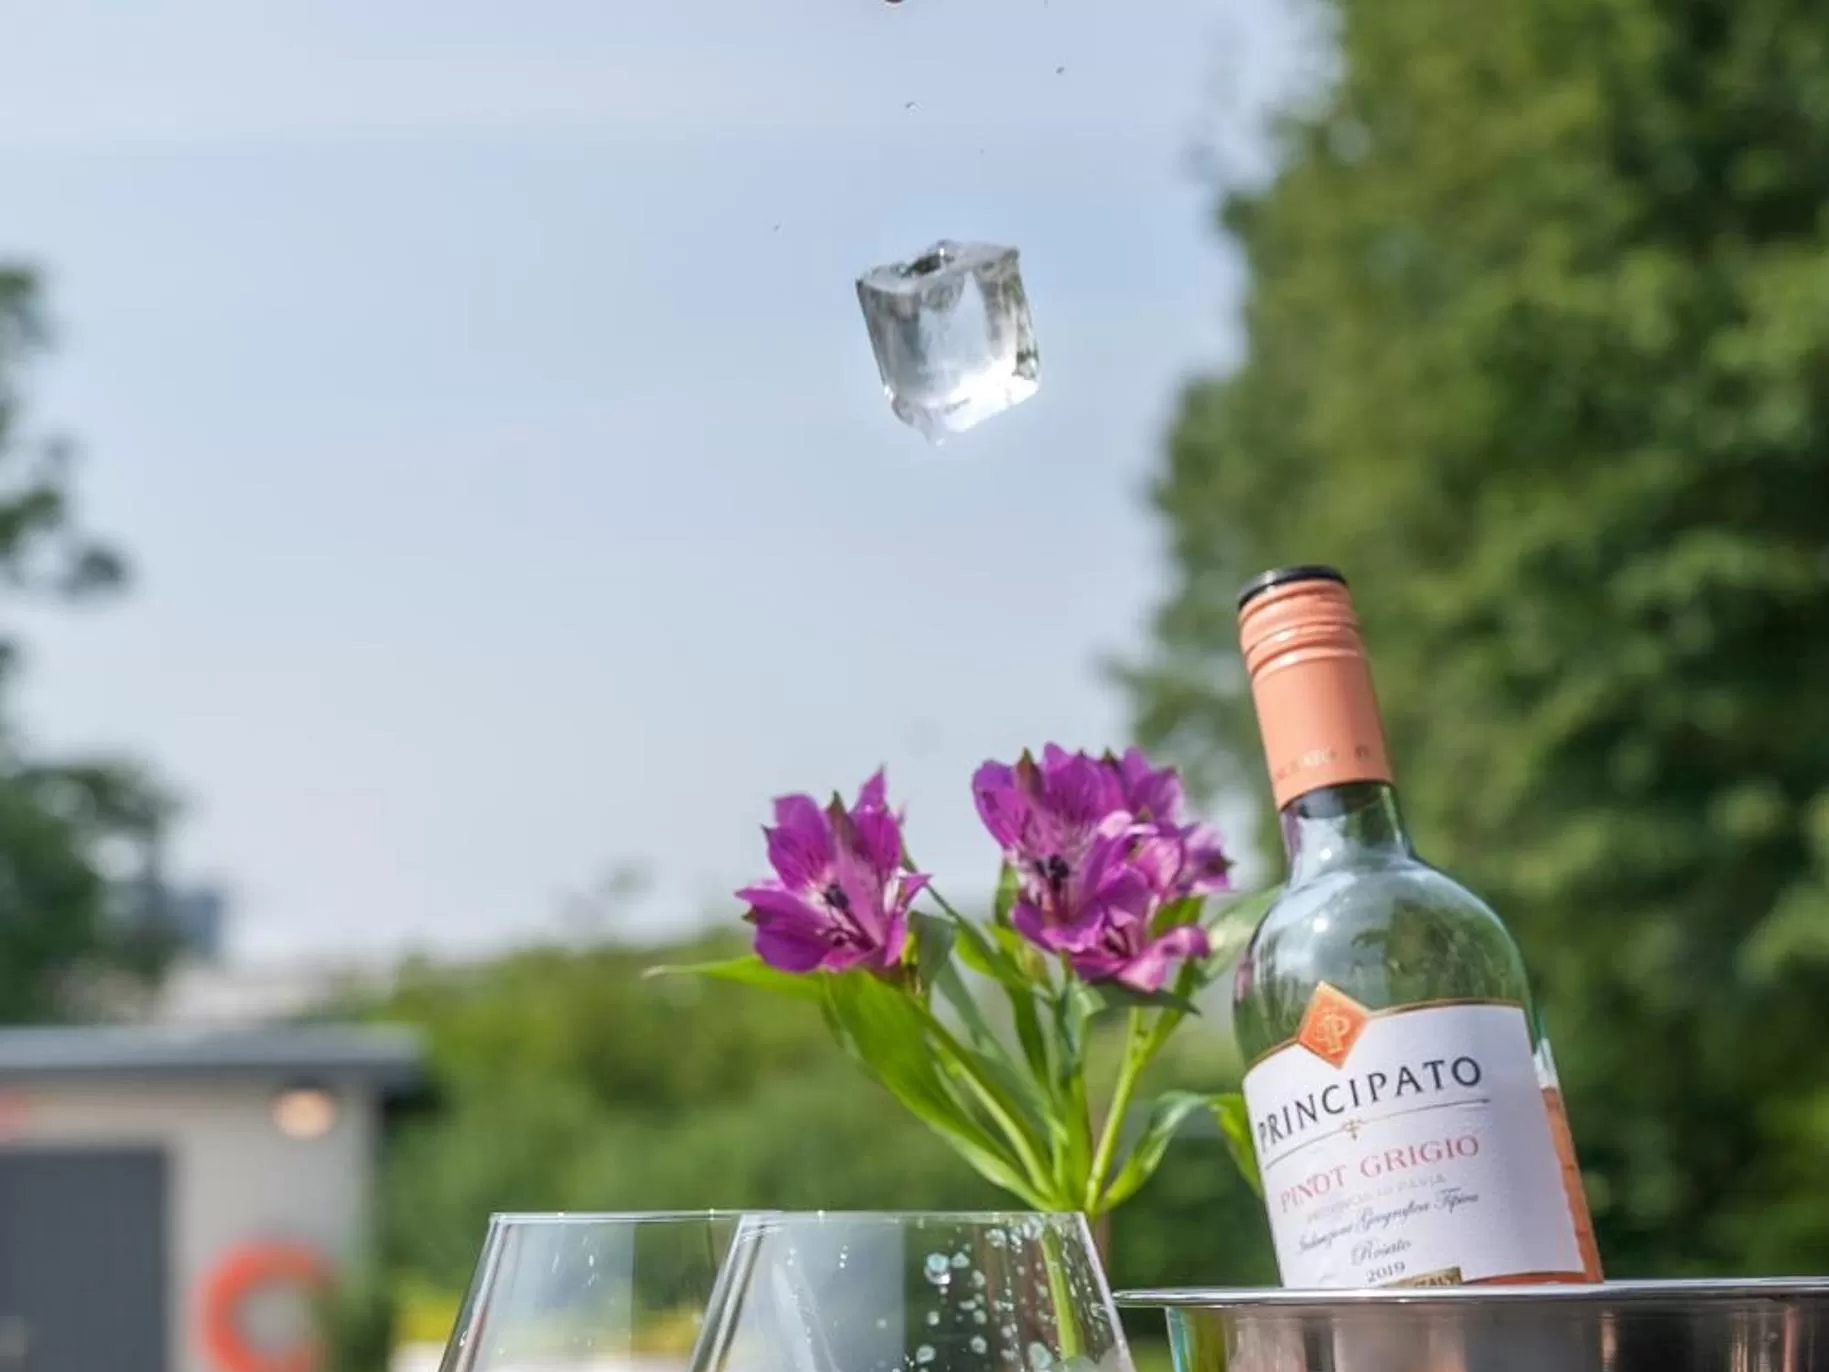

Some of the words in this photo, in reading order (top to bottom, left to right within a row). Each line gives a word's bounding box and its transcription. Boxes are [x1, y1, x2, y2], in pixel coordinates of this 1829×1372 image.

[1257, 1056, 1481, 1153] PRINCIPATO
[1279, 1165, 1347, 1213] PINOT
[1360, 1134, 1479, 1178] GRIGIO
[1367, 1261, 1405, 1282] 2019
